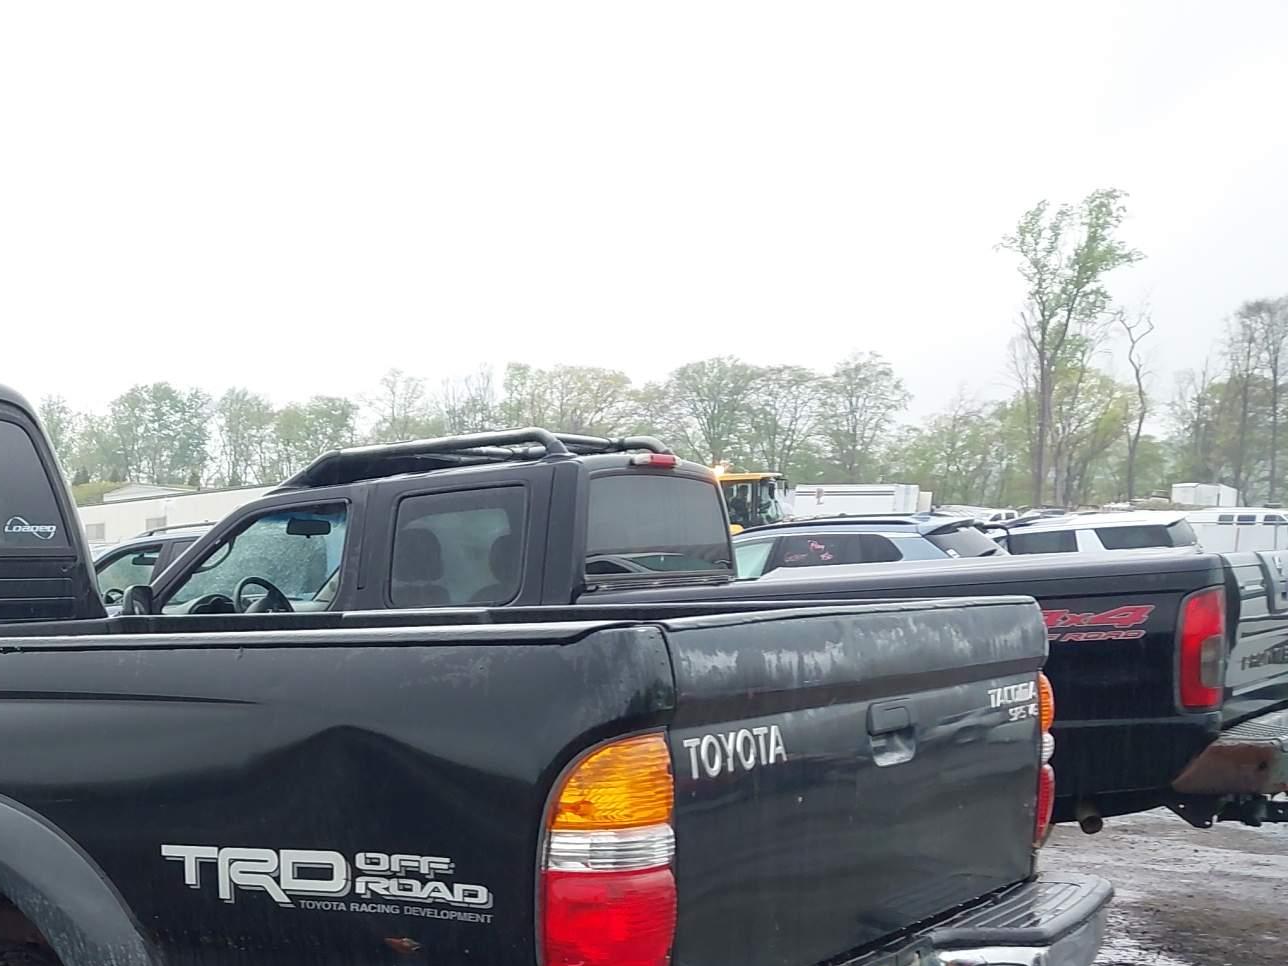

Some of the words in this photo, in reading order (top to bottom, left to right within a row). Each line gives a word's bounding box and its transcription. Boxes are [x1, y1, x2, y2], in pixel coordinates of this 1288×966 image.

[1059, 629, 1146, 642] ROAD
[682, 725, 788, 781] TOYOTA
[160, 844, 352, 908] TRD
[355, 852, 455, 879] OFF
[355, 876, 493, 909] ROAD
[299, 899, 347, 912] TOYOTA
[349, 903, 400, 914] RACING
[403, 906, 493, 924] DEVELOPMENT
